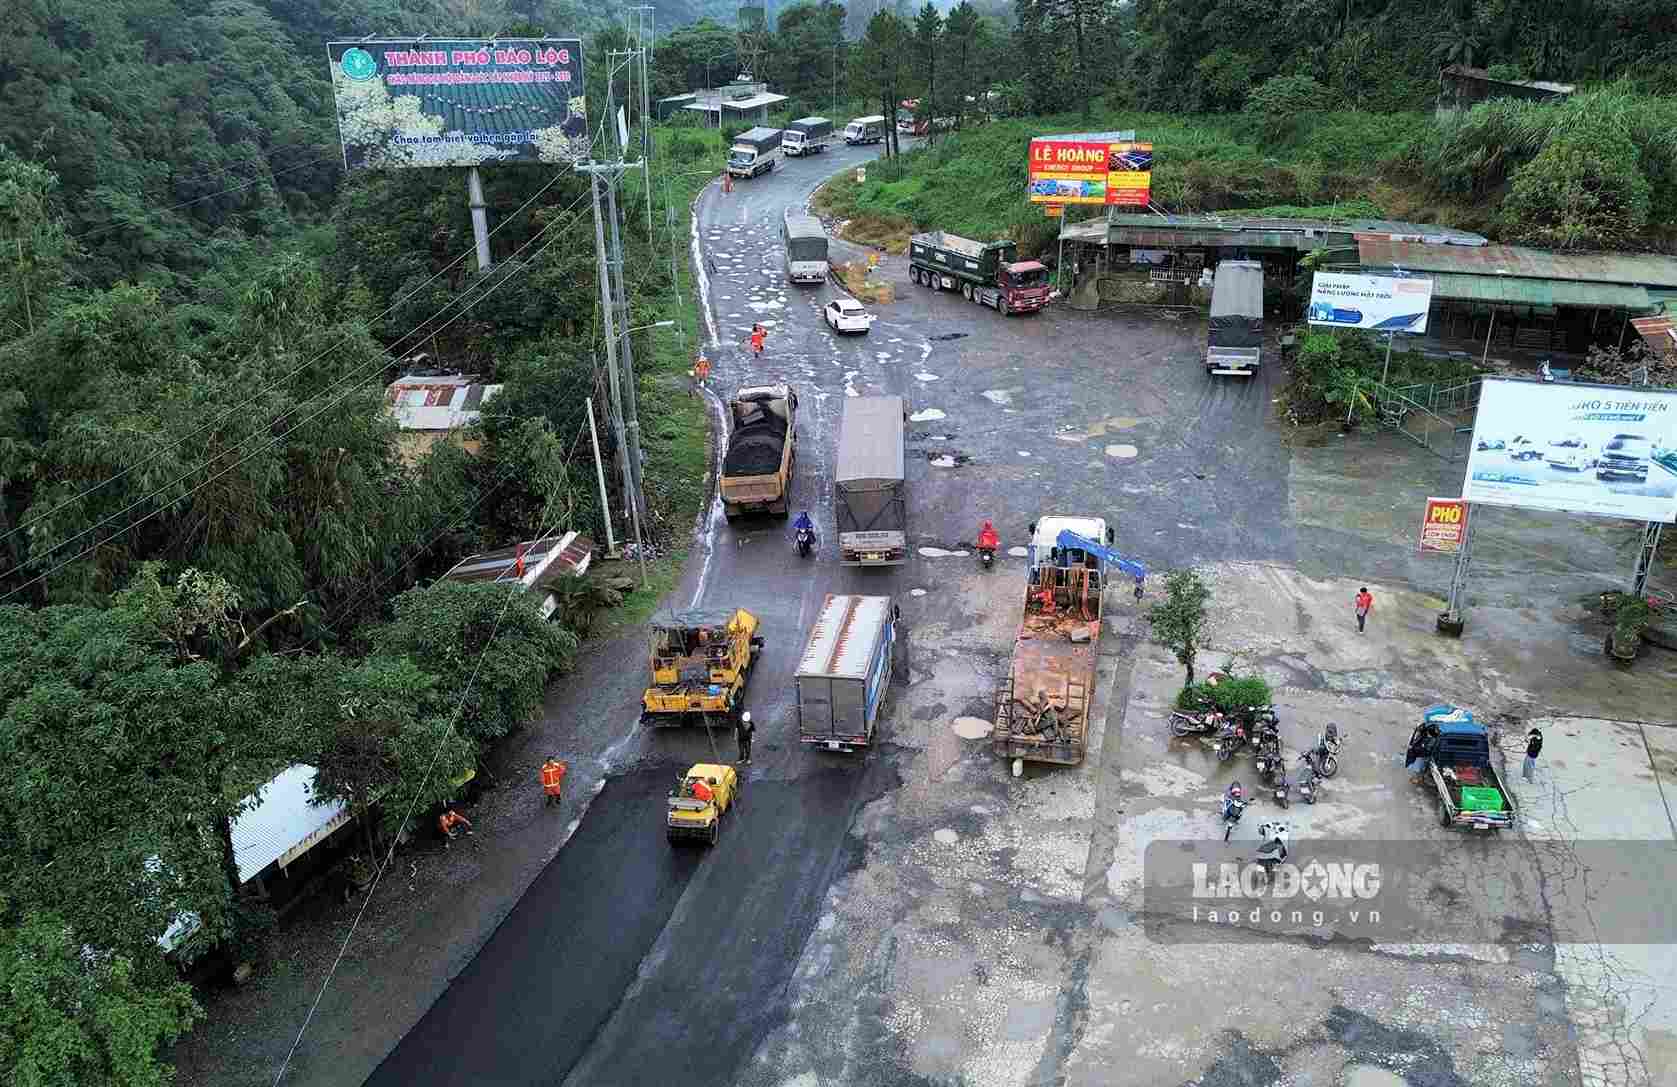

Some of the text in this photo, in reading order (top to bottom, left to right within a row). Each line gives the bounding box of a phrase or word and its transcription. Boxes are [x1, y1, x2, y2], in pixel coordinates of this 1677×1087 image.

[1035, 145, 1053, 161] LÊ
[1057, 145, 1105, 162] HOÀNG
[1604, 400, 1612, 410] 5
